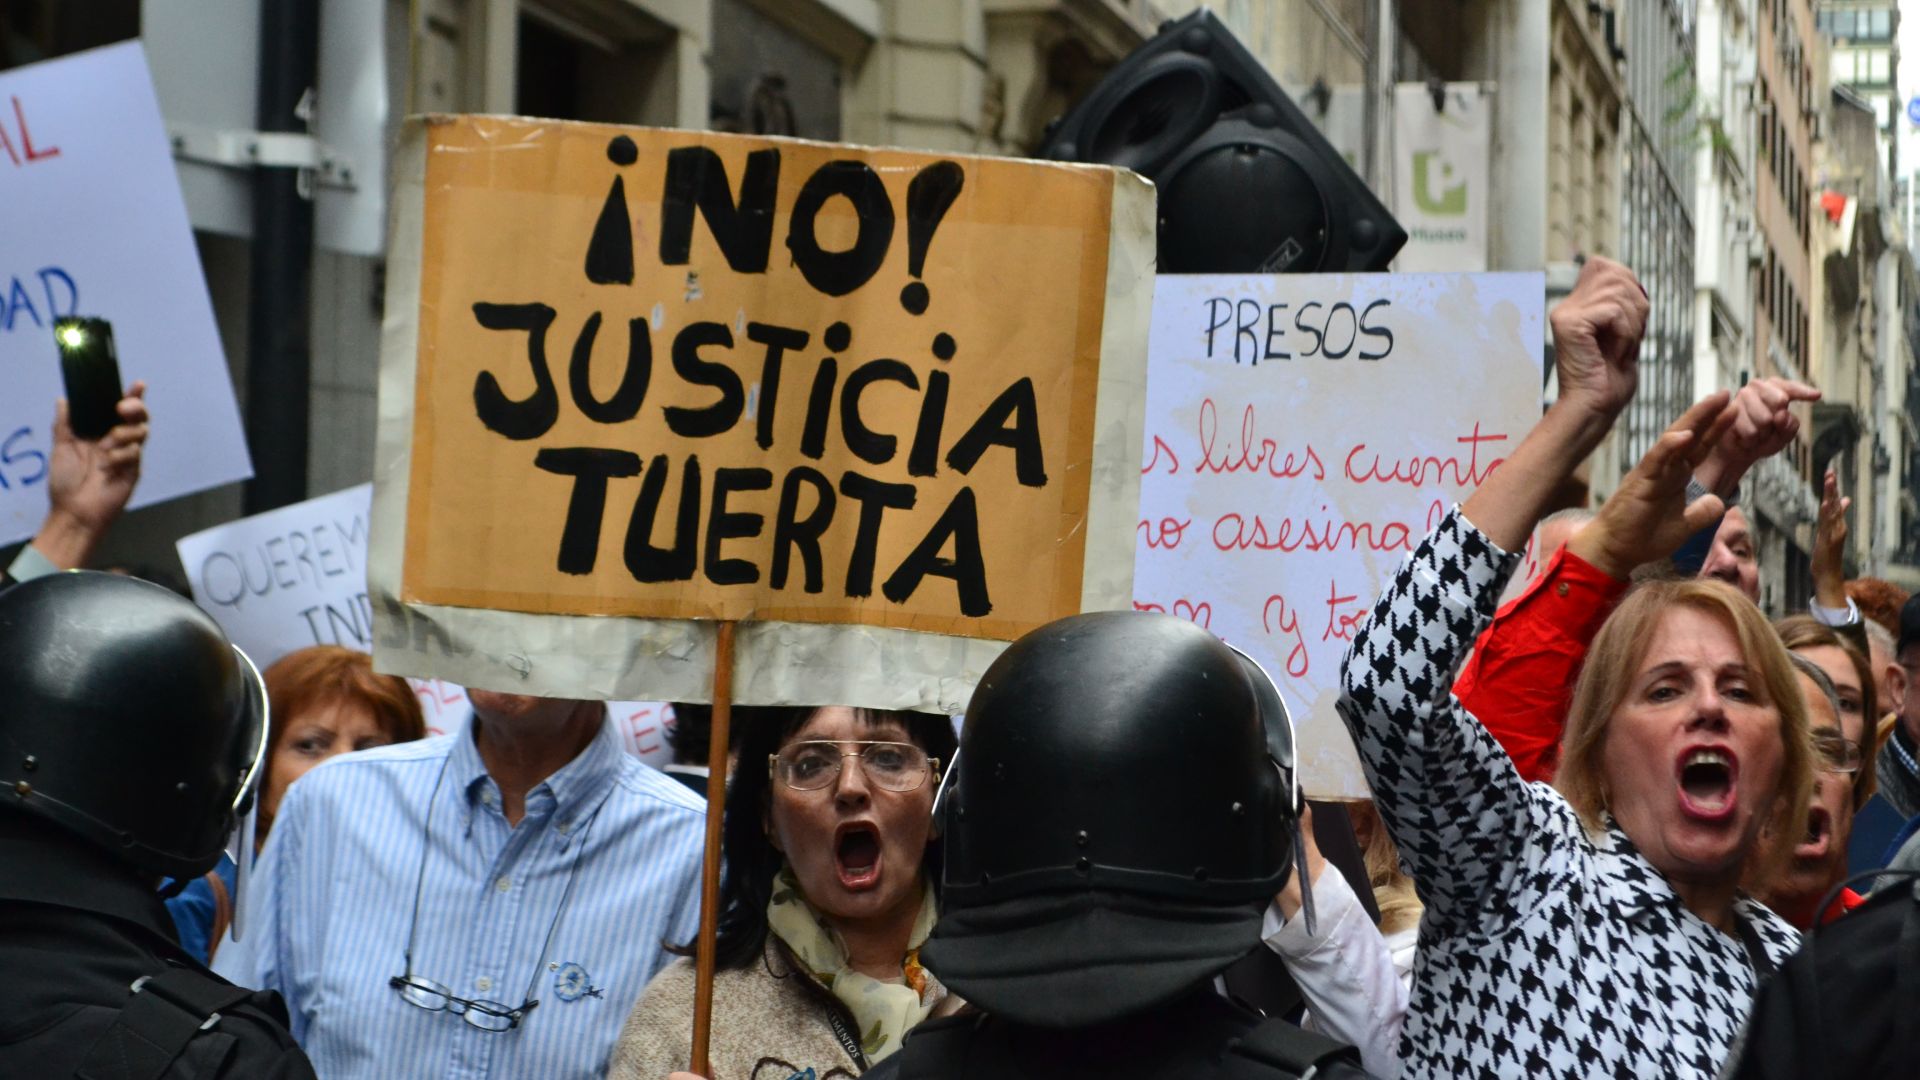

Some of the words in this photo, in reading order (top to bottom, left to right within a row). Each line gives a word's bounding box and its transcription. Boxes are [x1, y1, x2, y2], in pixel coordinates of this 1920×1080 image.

[584, 136, 966, 316] ¡NO!
[0, 266, 79, 331] AD
[1204, 298, 1394, 366] PRESOS
[472, 302, 1049, 489] JUSTICIA
[1195, 398, 1325, 481] libres
[534, 447, 993, 618] TUERTA
